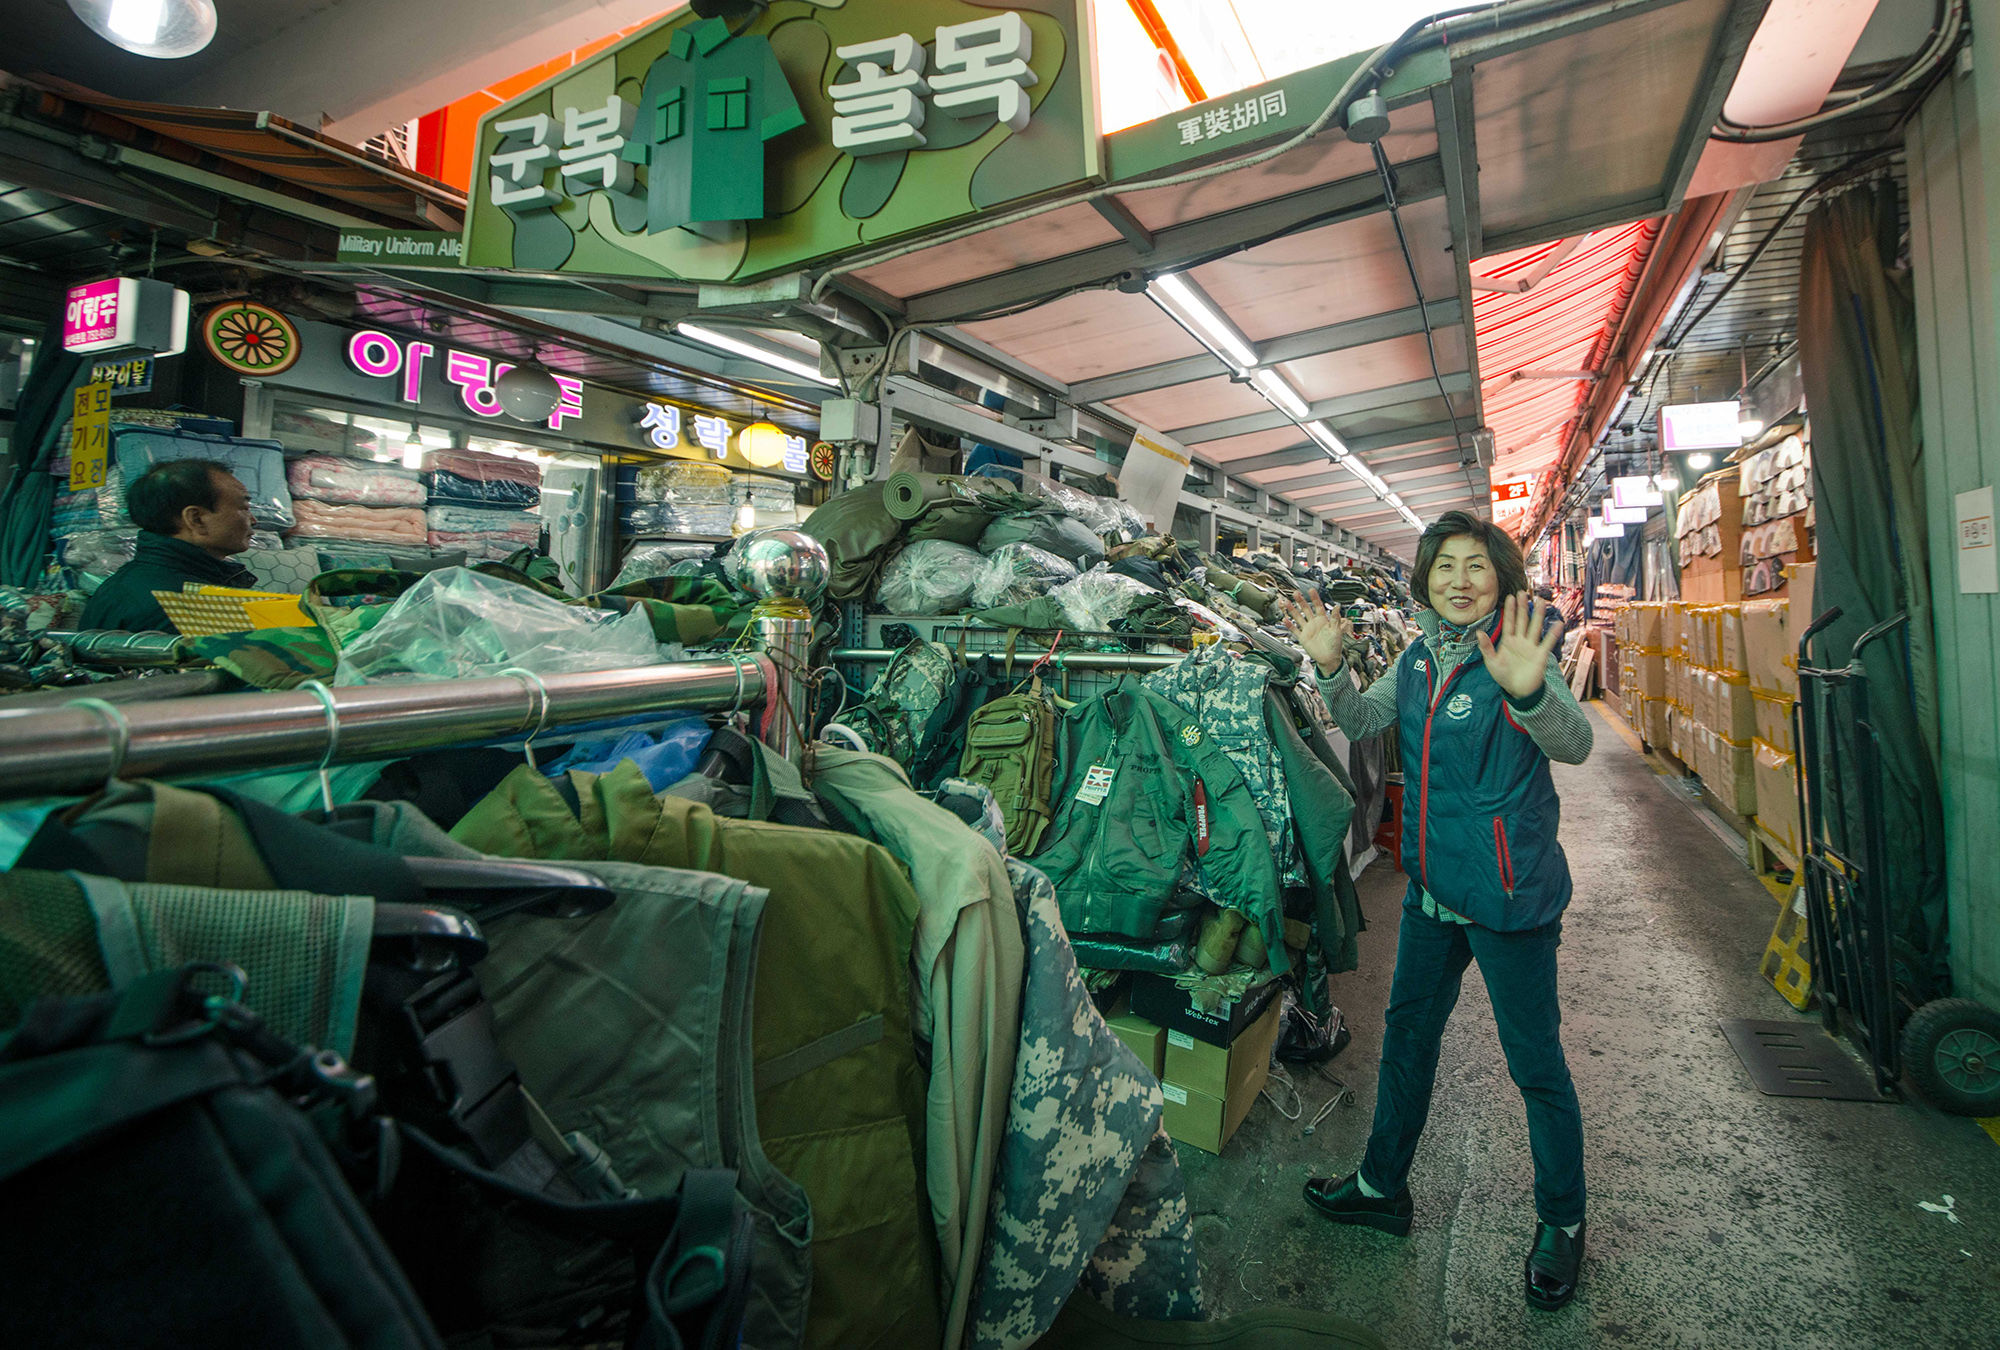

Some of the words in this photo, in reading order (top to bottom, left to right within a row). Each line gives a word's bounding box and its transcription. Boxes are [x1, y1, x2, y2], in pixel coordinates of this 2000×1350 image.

[489, 95, 632, 208] 군복
[828, 11, 1038, 150] 골목
[1177, 89, 1287, 145] 軍裝胡同
[339, 234, 383, 256] Military
[385, 236, 435, 256] Uniform
[437, 238, 463, 257] Alle
[640, 403, 810, 473] 성락불
[1184, 1008, 1220, 1027] Web-tex
